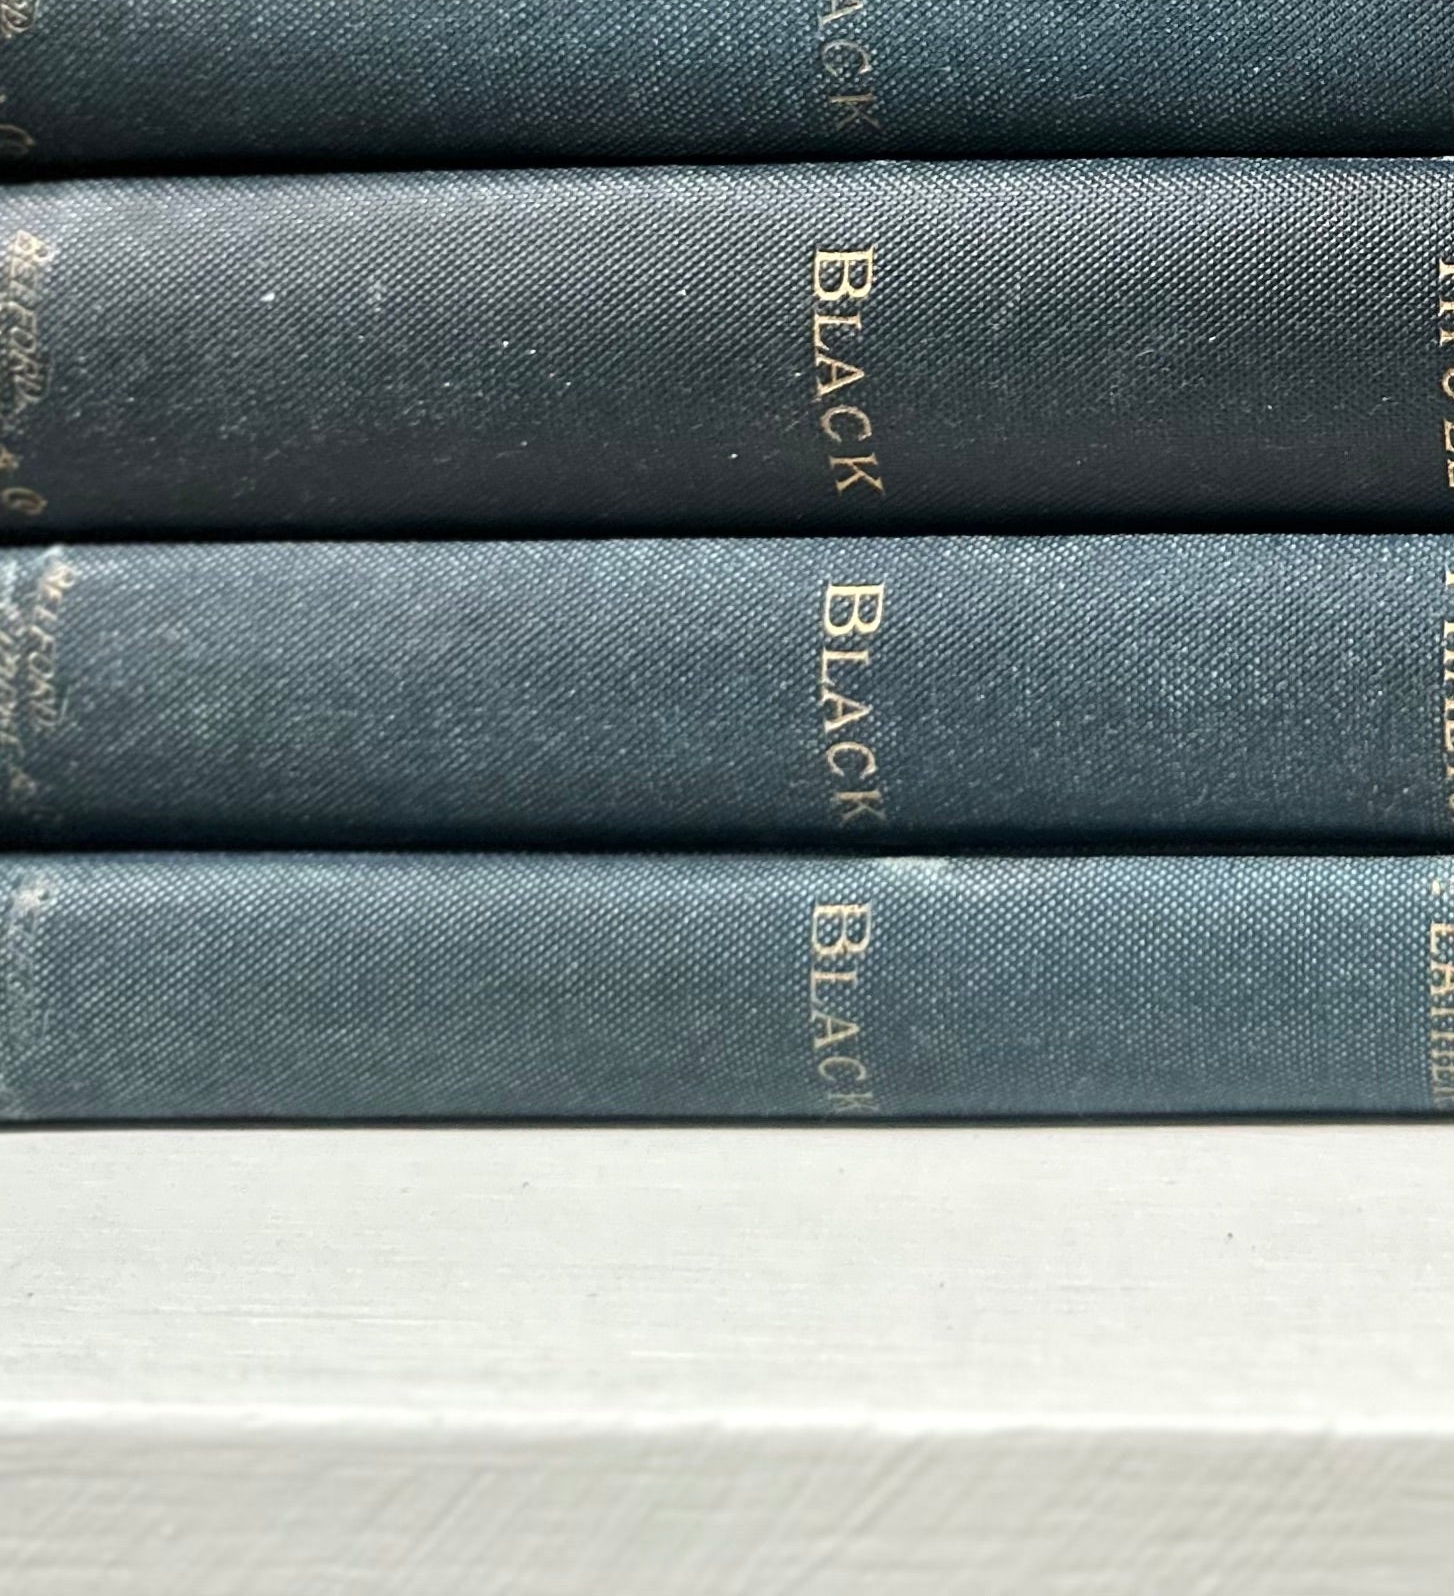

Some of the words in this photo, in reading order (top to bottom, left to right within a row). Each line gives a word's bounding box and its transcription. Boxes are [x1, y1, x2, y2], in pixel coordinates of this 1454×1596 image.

[811, 247, 886, 499] BLACK
[819, 581, 886, 830] BLACK
[809, 901, 880, 1115] BLACK
